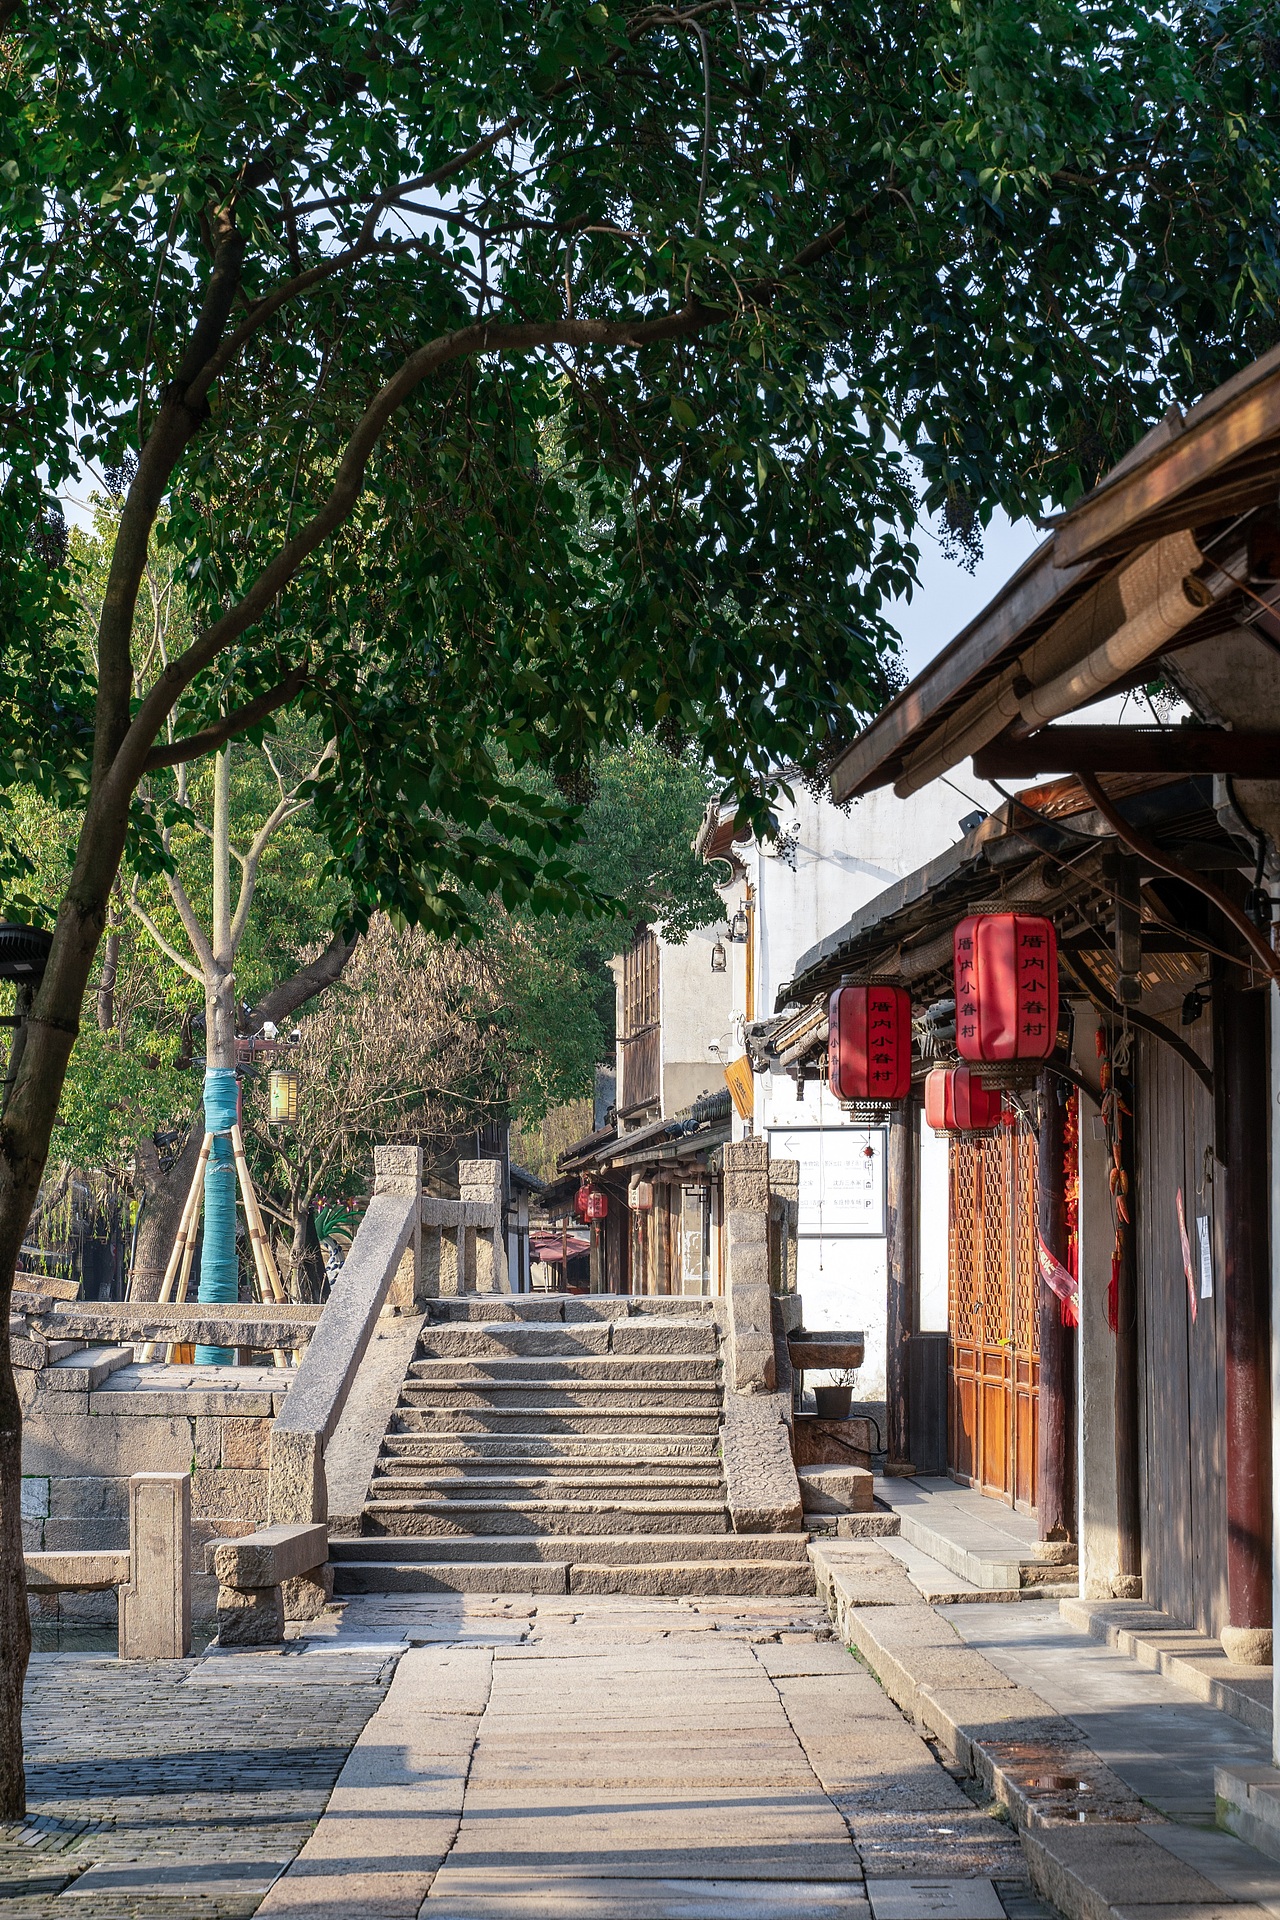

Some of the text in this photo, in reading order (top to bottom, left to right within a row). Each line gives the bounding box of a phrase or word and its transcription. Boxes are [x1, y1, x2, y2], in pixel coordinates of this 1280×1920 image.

[957, 937, 977, 1038] 厝内小眷村
[1020, 934, 1047, 1036] 厝内小眷村
[870, 1001, 894, 1081] 厝内小眷村
